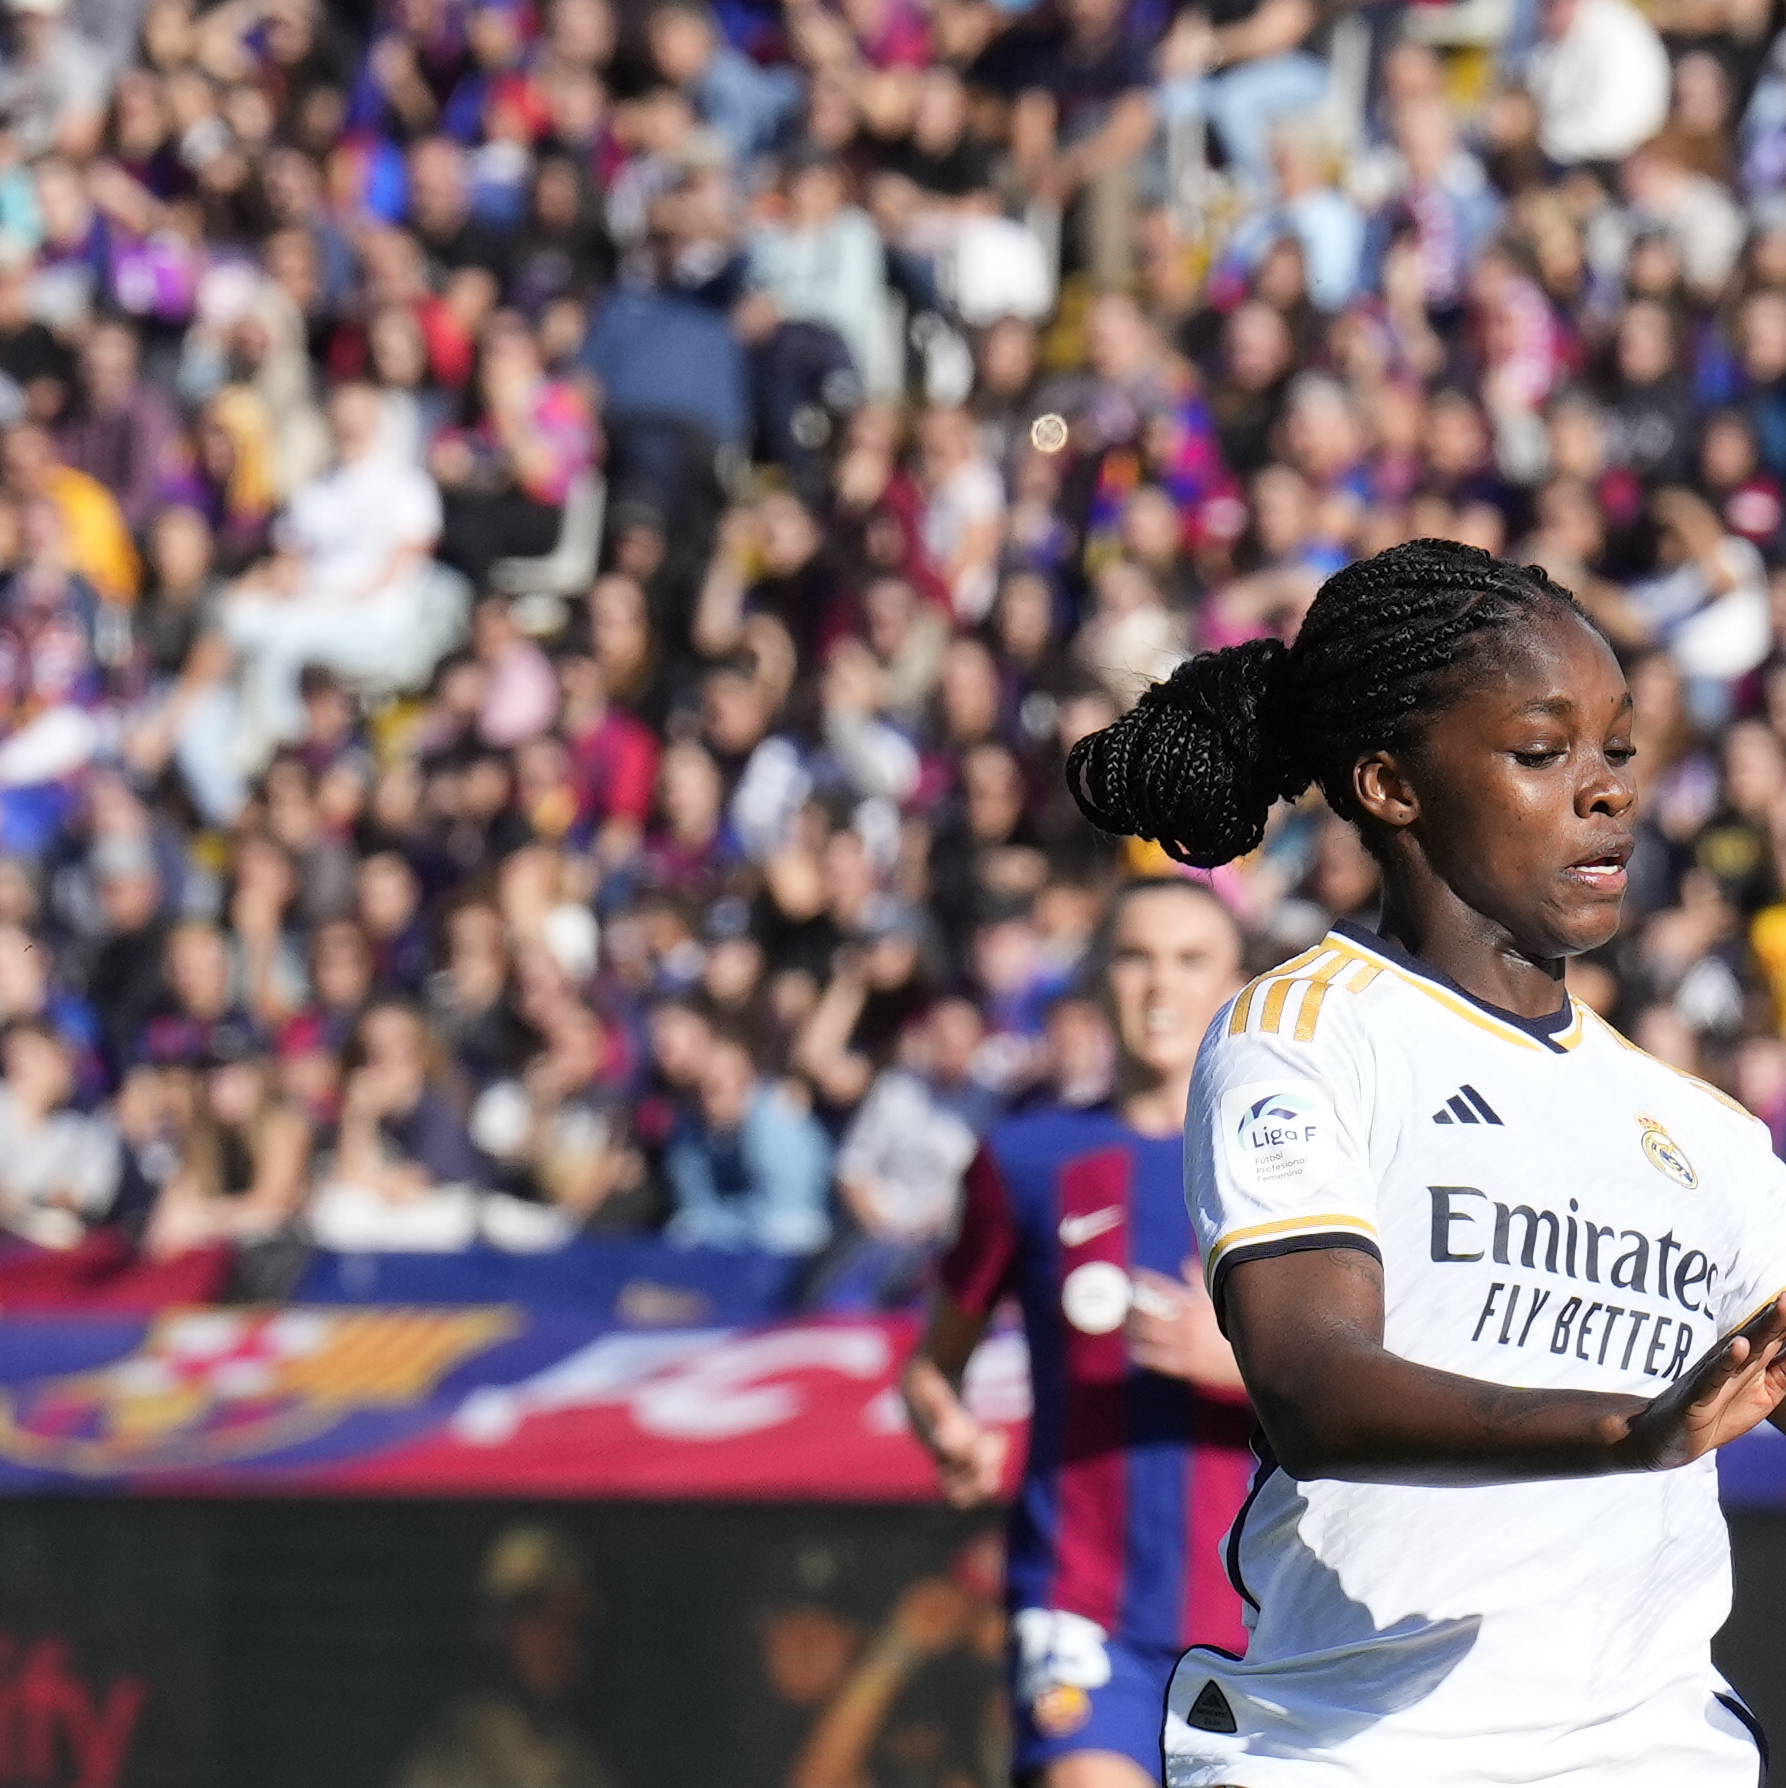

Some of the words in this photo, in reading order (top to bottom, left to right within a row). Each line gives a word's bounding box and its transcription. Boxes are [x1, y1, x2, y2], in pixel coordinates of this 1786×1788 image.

[1252, 1126, 1298, 1148] Liga
[1305, 1126, 1317, 1142] F
[1428, 1185, 1719, 1321] Emirates
[1471, 1282, 1551, 1347] FLY
[1550, 1295, 1695, 1382] BETTER
